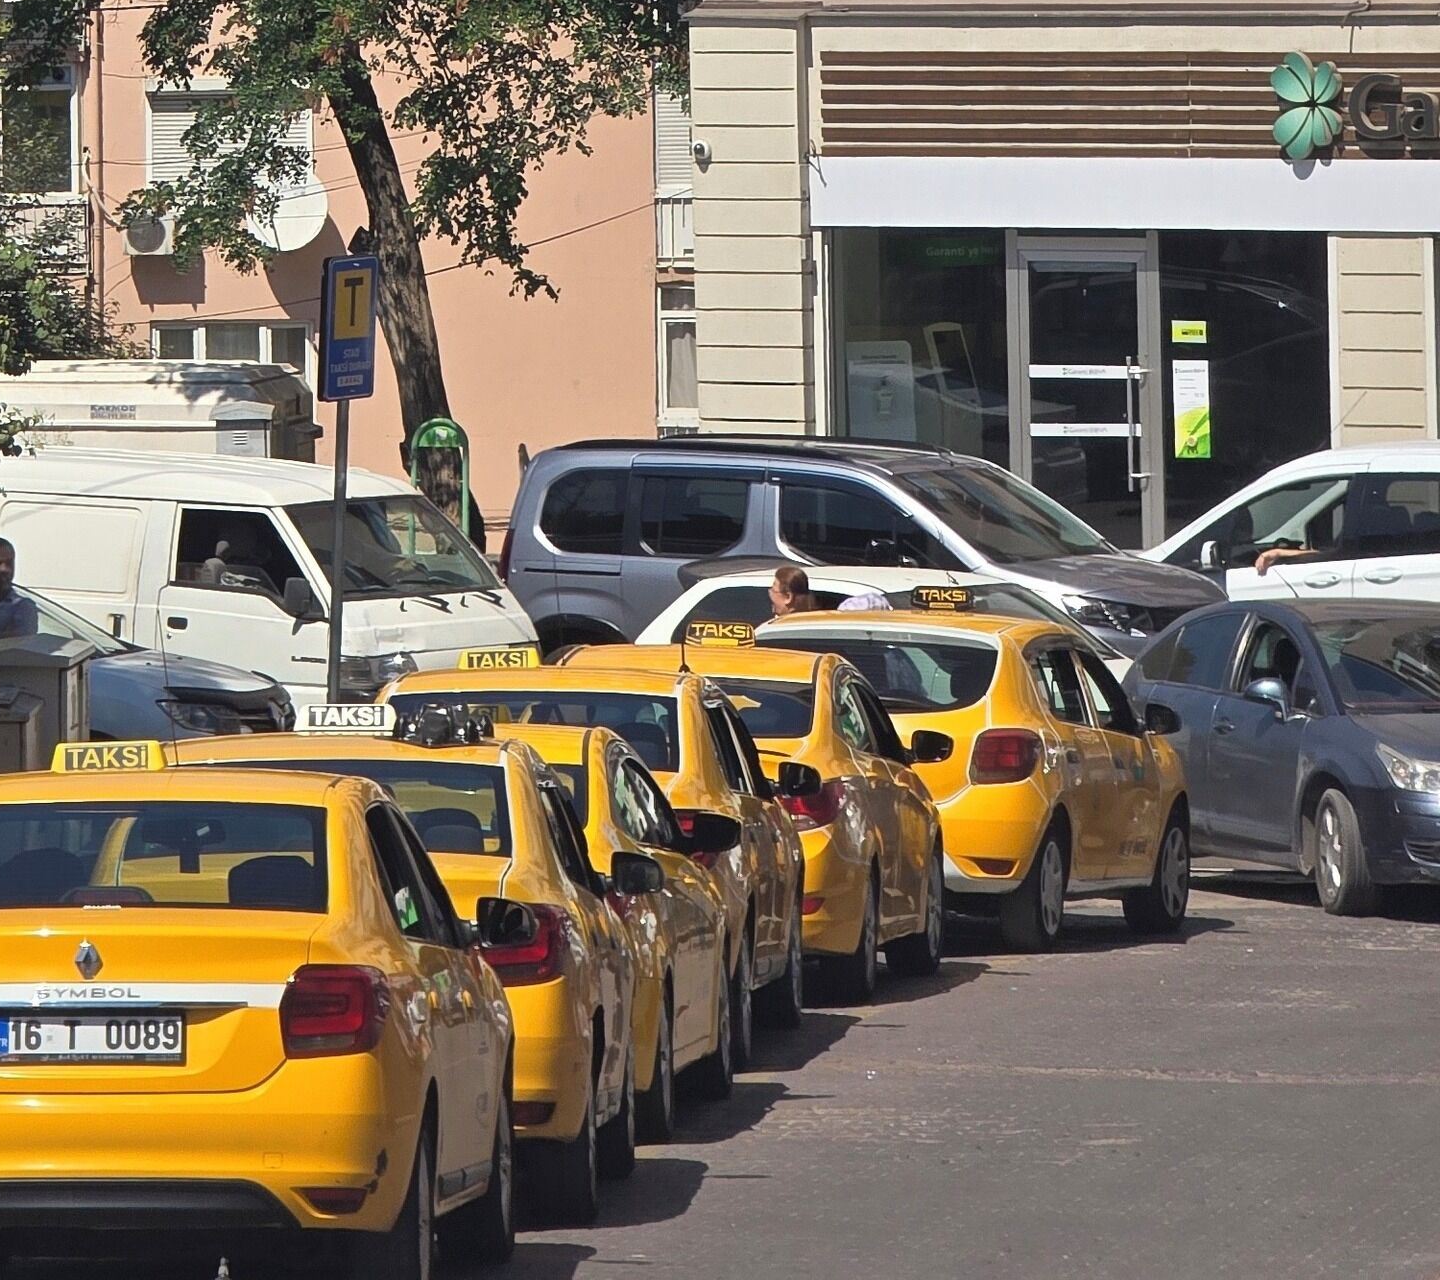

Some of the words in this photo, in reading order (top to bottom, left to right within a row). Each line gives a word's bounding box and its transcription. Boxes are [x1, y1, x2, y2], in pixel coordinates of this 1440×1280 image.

[344, 277, 364, 326] T
[37, 987, 141, 999] SYMBOL
[11, 1019, 42, 1051] 16
[64, 1019, 81, 1050] T
[105, 1019, 180, 1051] 0089
